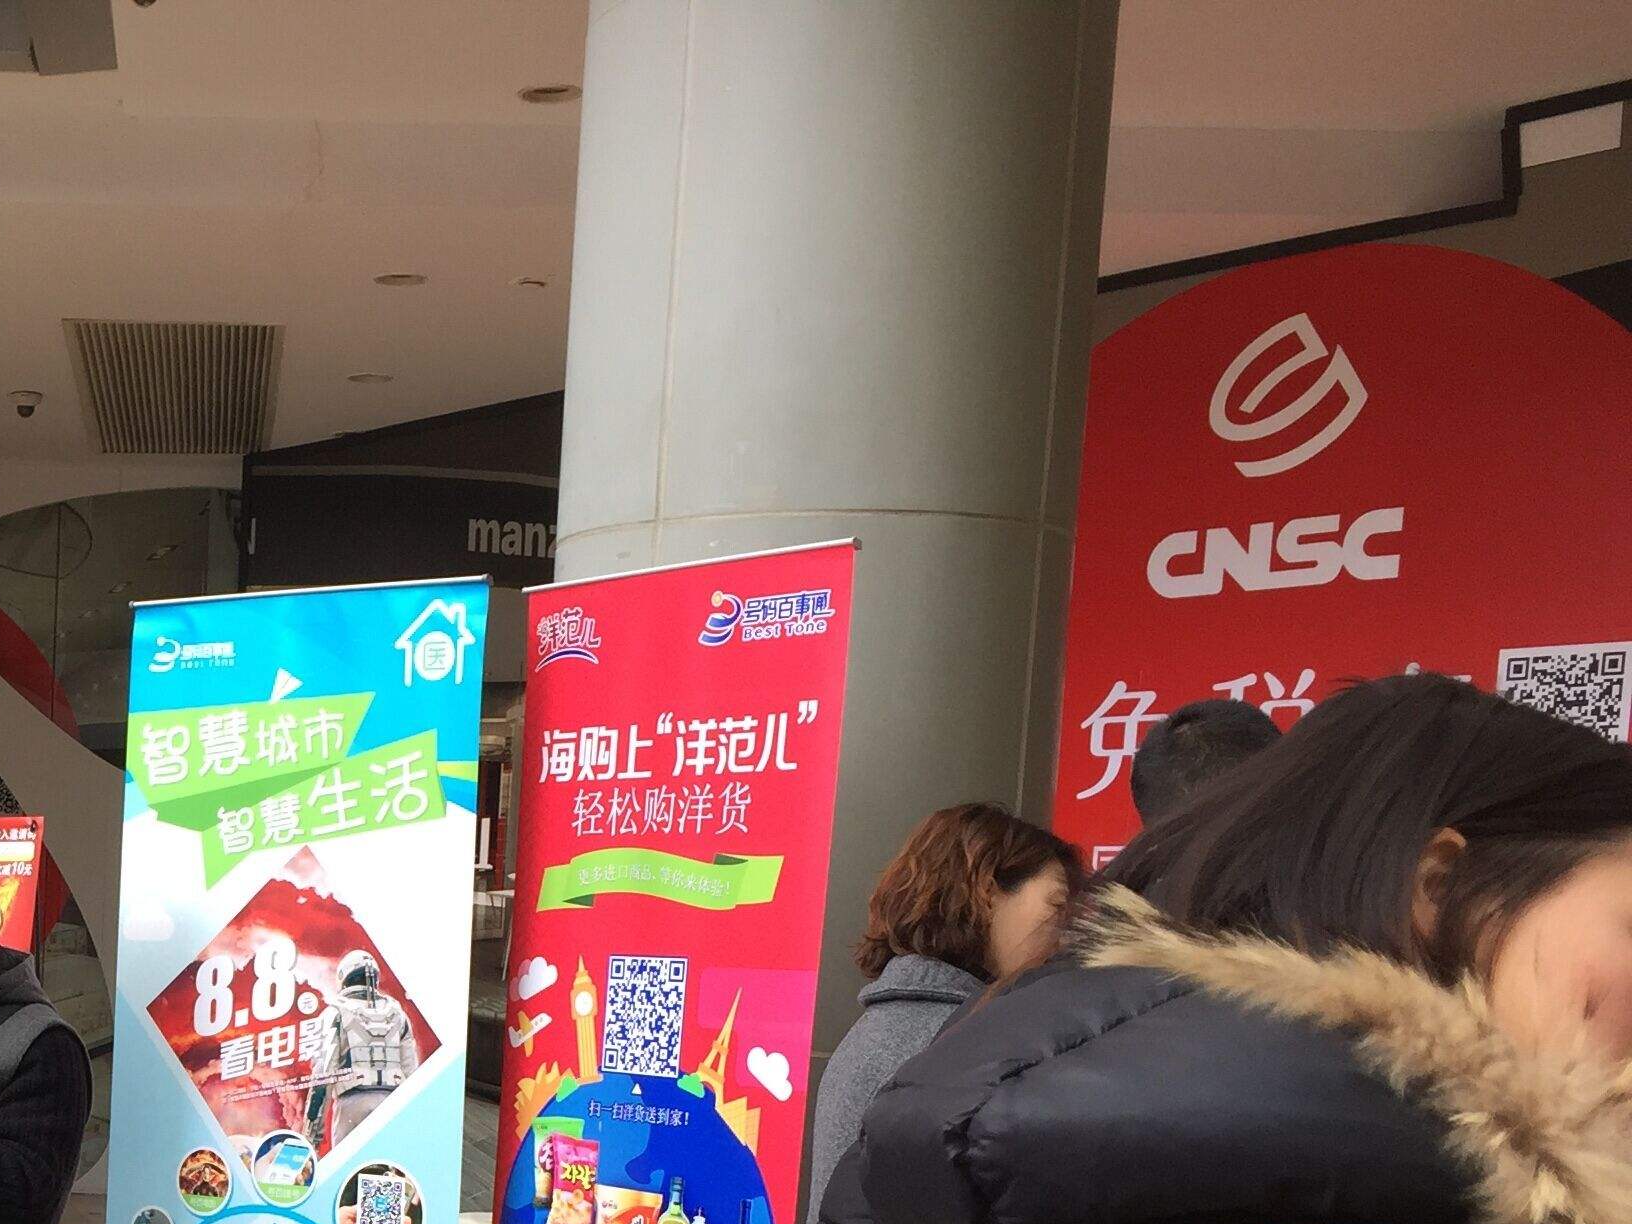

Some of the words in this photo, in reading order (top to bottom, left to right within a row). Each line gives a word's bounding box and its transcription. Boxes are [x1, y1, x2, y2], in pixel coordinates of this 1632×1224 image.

[1147, 506, 1404, 599] CNSC
[741, 590, 836, 624] 号码百事通
[743, 625, 780, 641] Best
[786, 619, 827, 637] Tone
[140, 706, 345, 786] 智慧城市
[217, 750, 430, 856] 智慧生活
[571, 781, 752, 838] 轻松购洋货
[219, 1016, 340, 1081] 看电影
